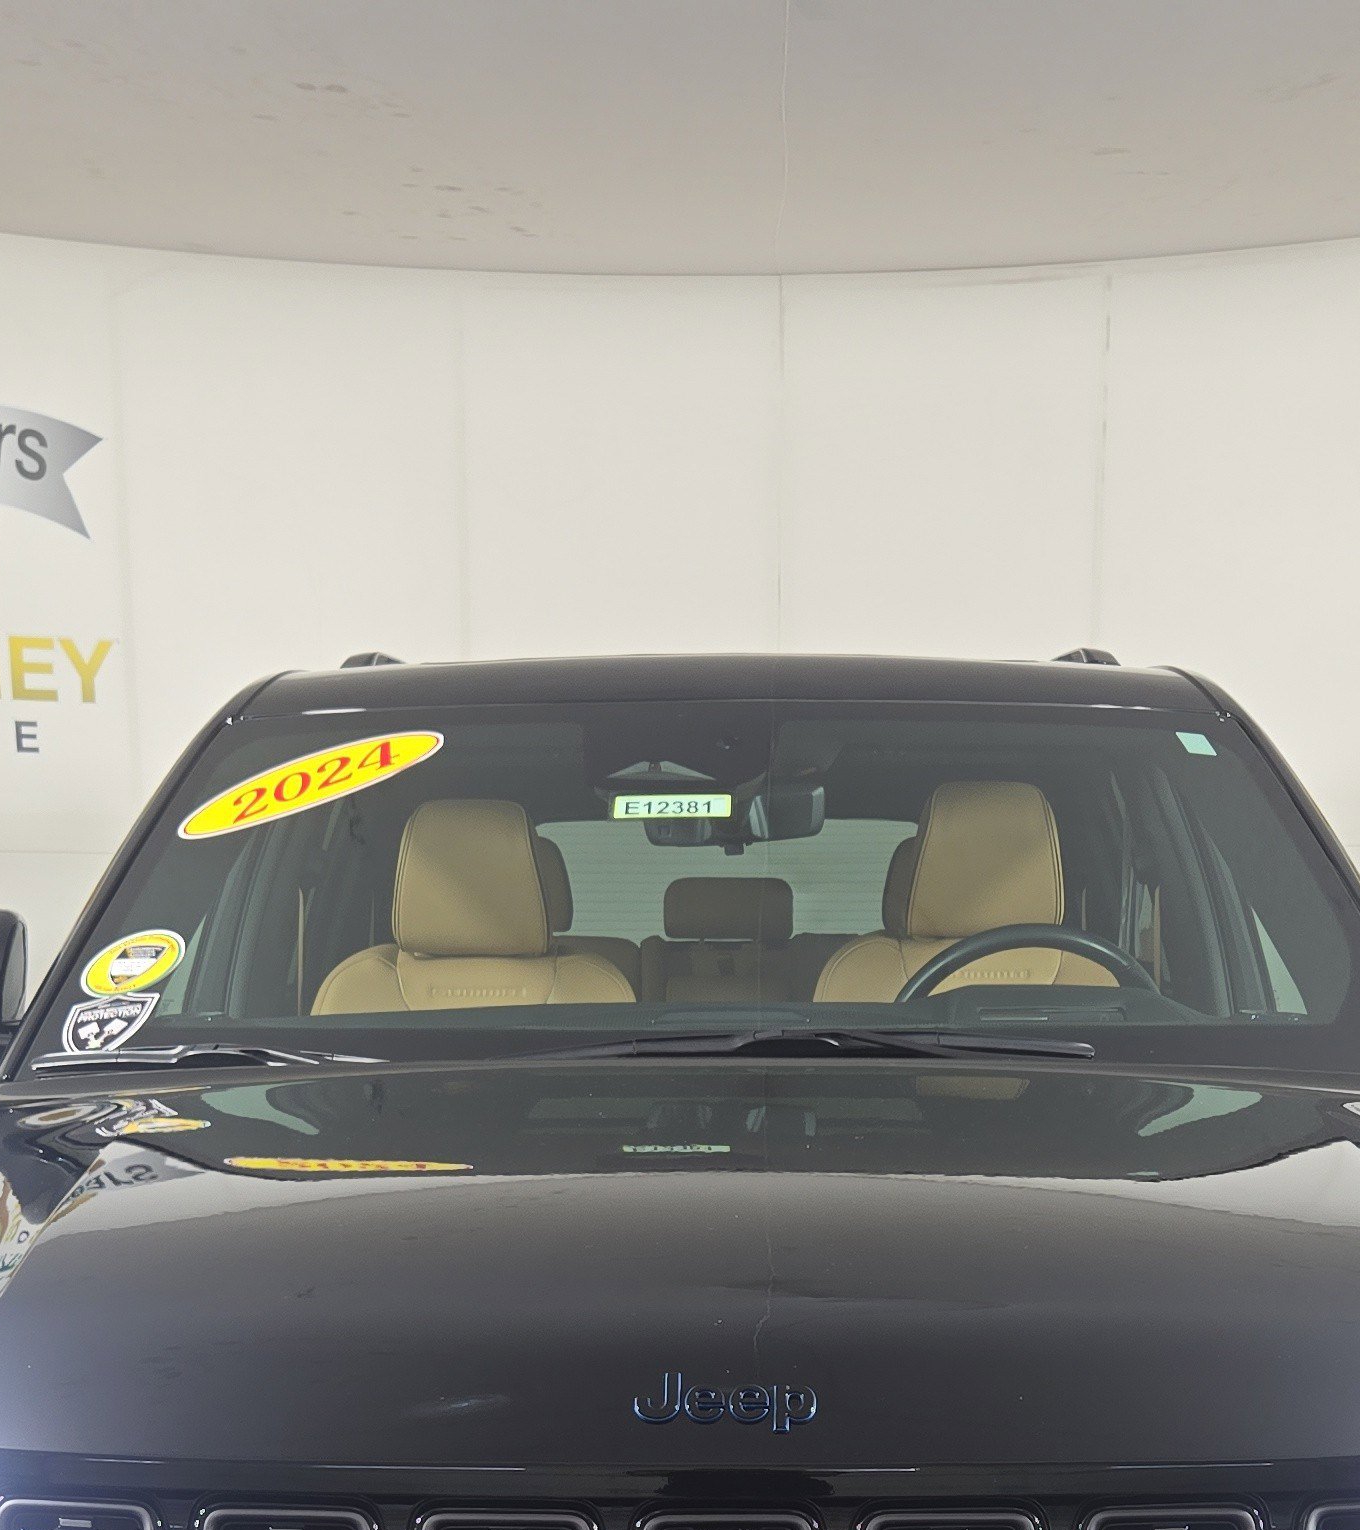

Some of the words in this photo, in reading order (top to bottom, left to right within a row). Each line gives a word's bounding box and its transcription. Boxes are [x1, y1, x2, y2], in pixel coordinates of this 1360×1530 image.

[232, 740, 400, 825] 2024
[624, 800, 712, 815] E12381
[634, 1372, 818, 1434] Jeep
